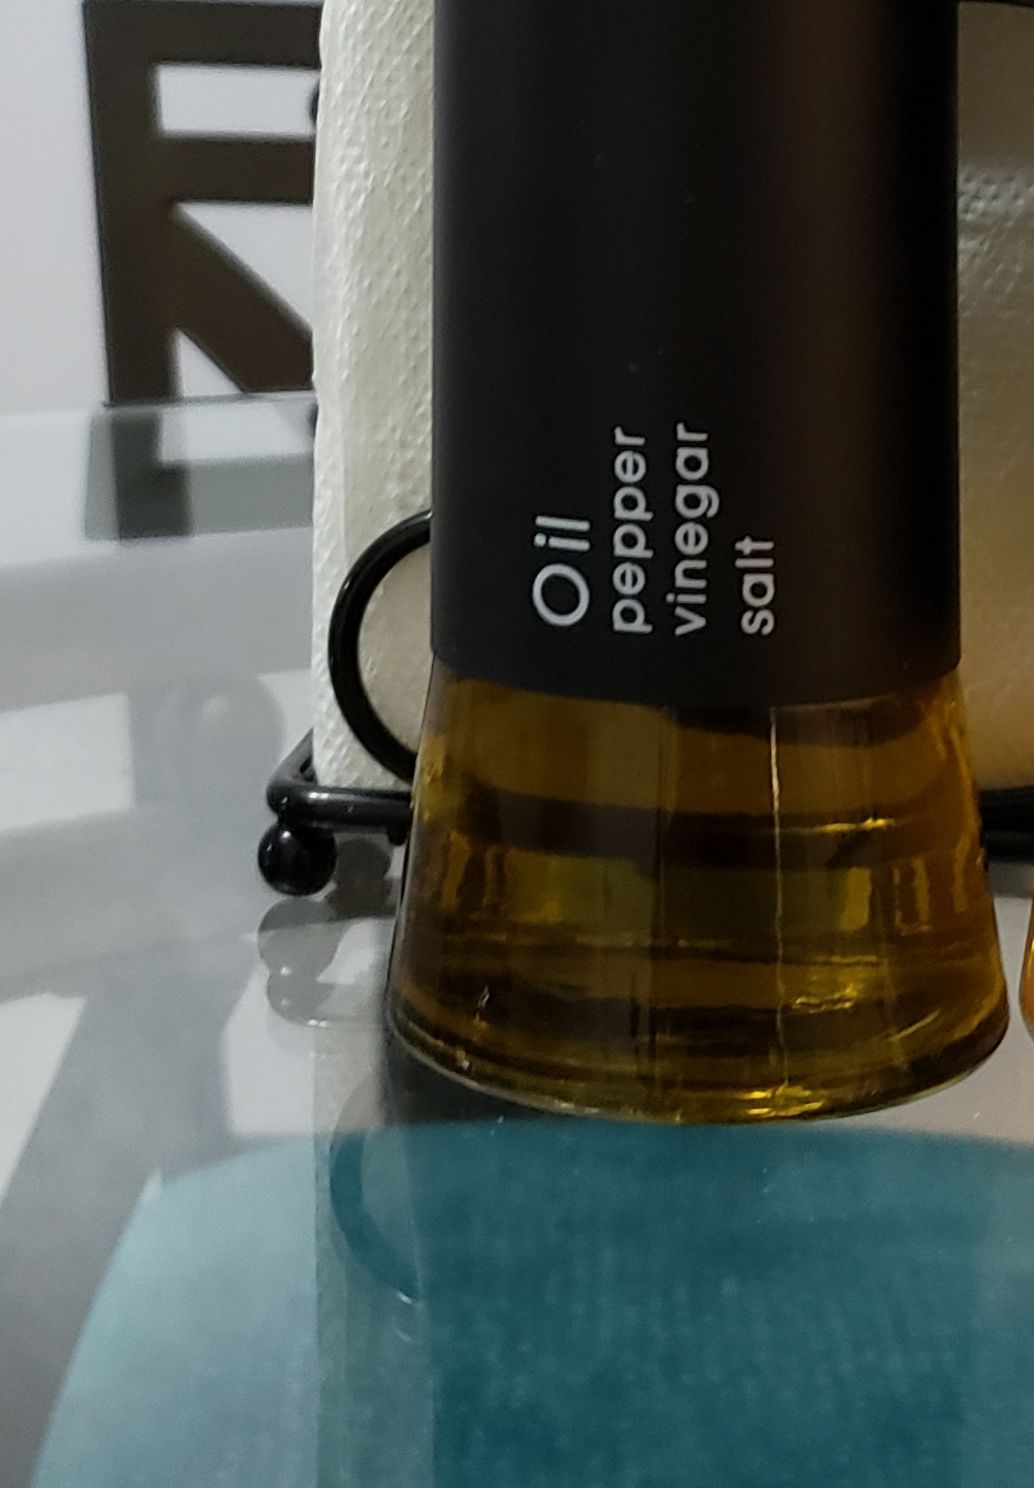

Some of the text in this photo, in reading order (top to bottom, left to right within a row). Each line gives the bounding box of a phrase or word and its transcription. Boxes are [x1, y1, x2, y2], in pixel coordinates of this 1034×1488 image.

[532, 515, 591, 627] Oil
[612, 426, 654, 634] pepper
[665, 422, 721, 636] vinegar
[734, 535, 776, 636] salt
